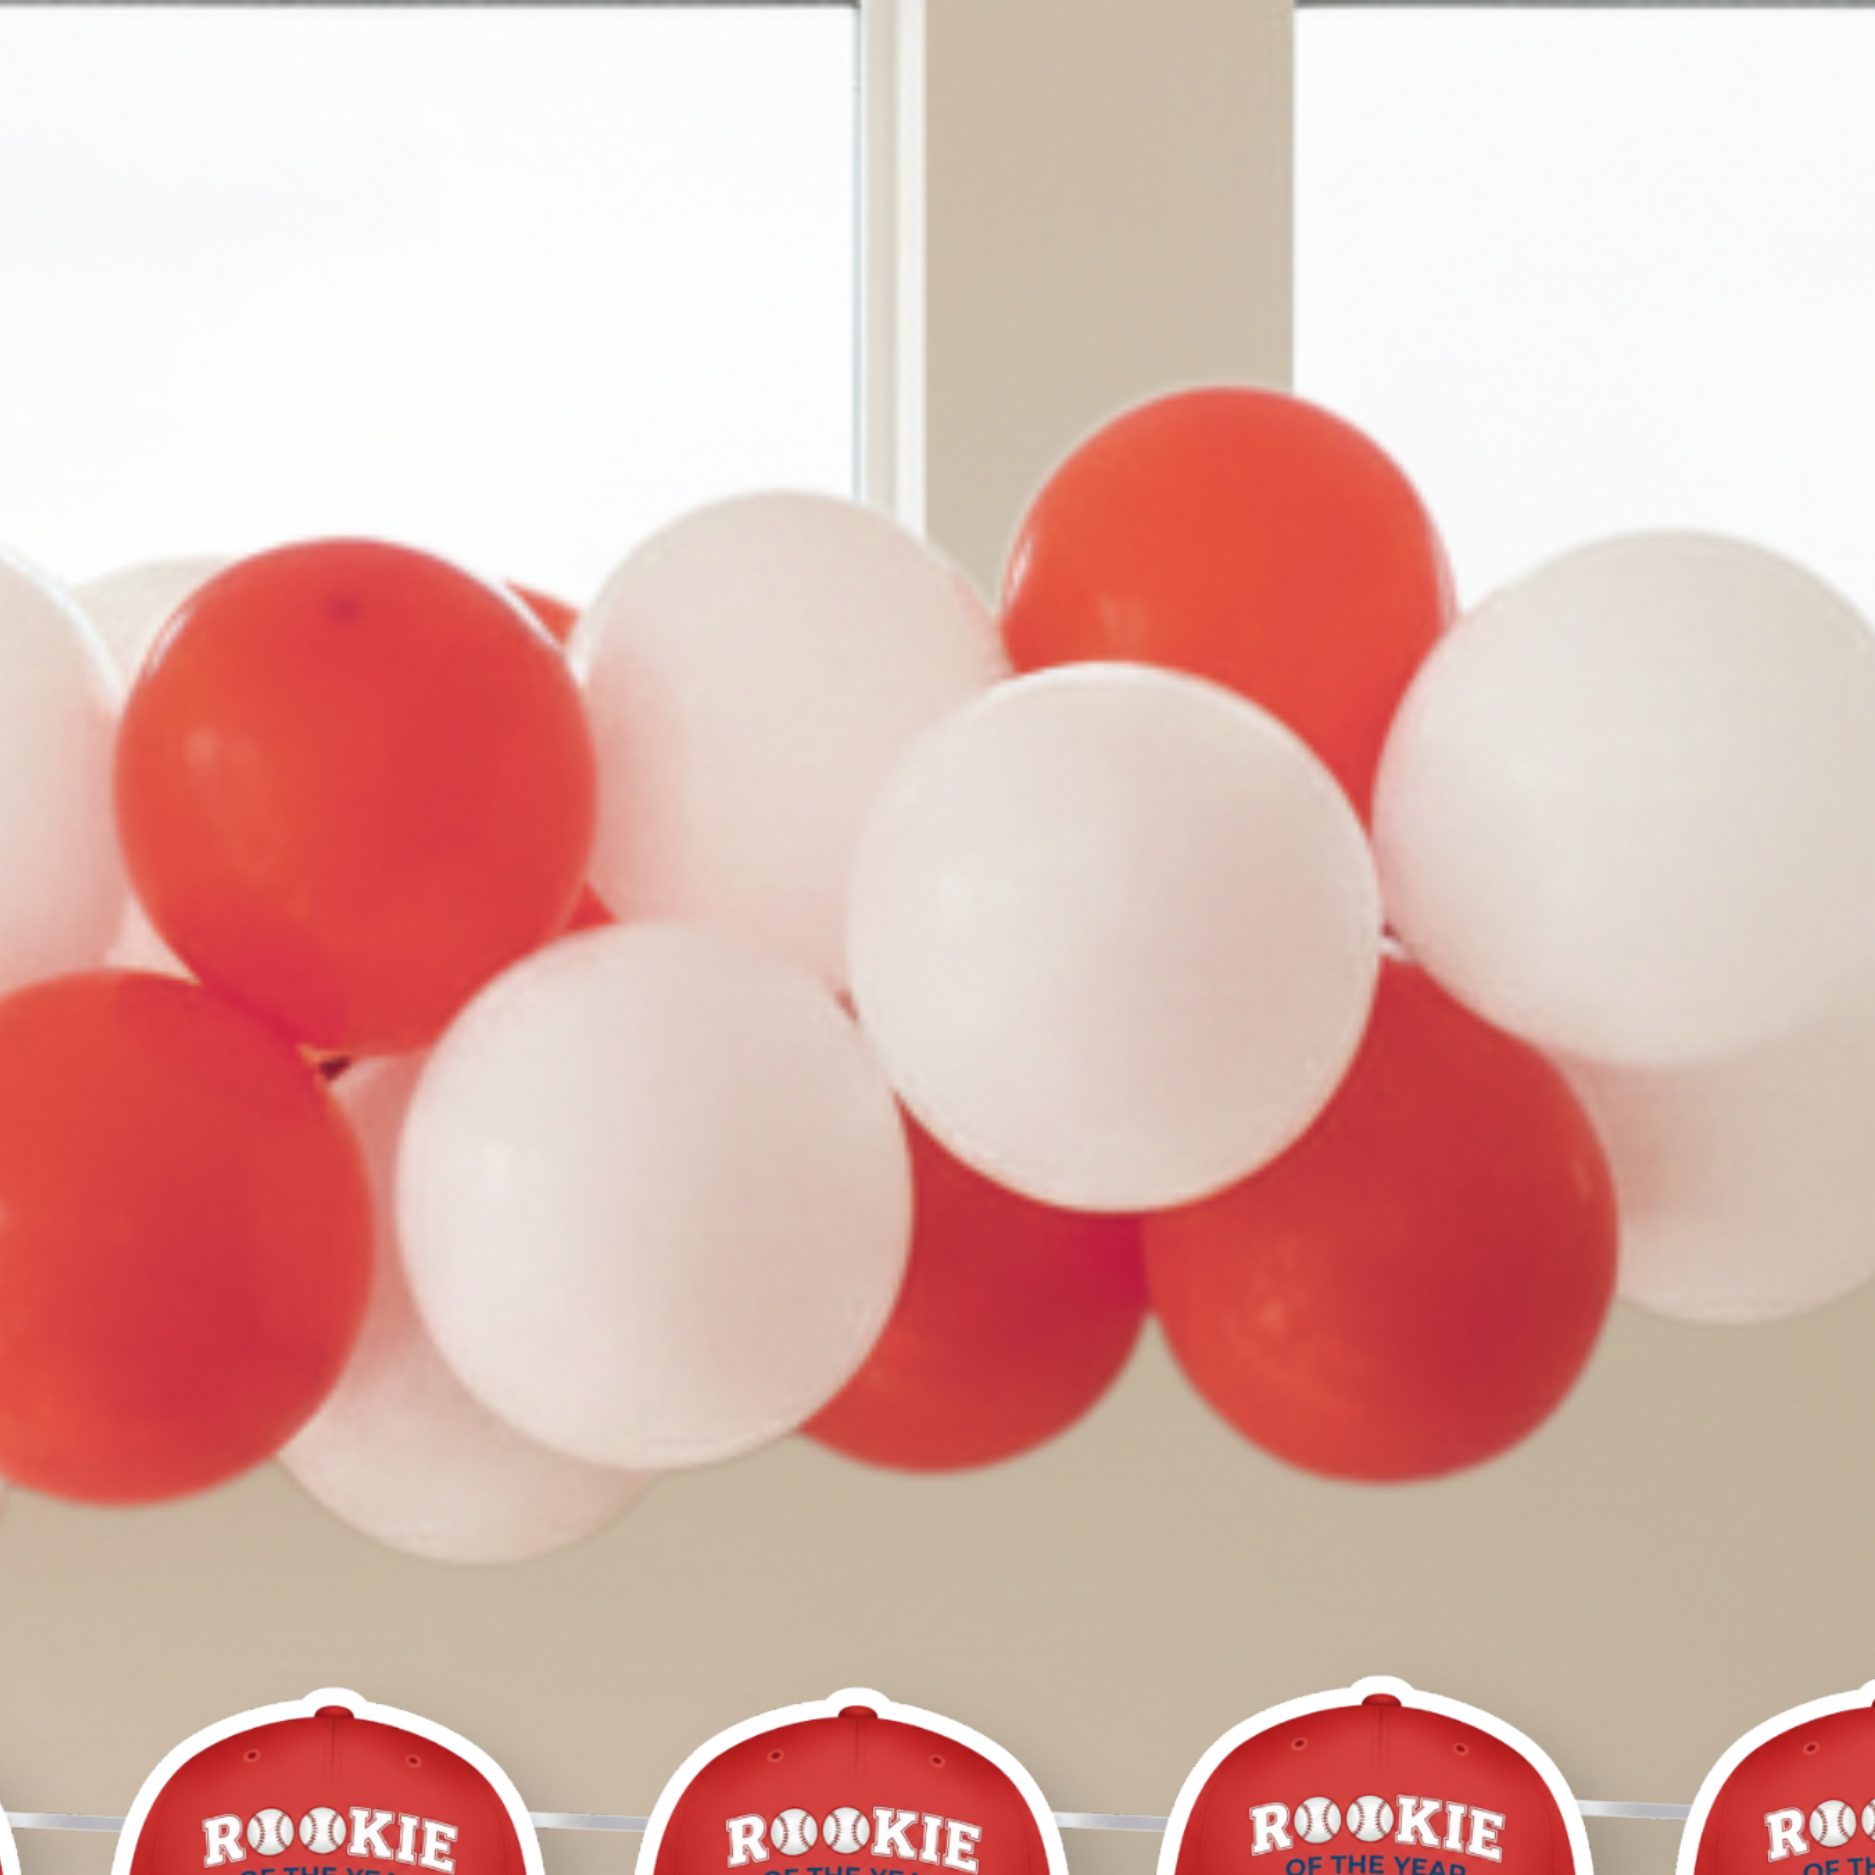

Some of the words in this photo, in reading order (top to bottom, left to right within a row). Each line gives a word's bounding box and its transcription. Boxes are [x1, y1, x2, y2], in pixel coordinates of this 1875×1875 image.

[202, 1806, 459, 1875] ROOKIE
[725, 1806, 982, 1875] ROOKIE
[1249, 1794, 1506, 1863] ROOKIE
[1764, 1798, 1875, 1863] RO
[1330, 1854, 1385, 1875] THE
